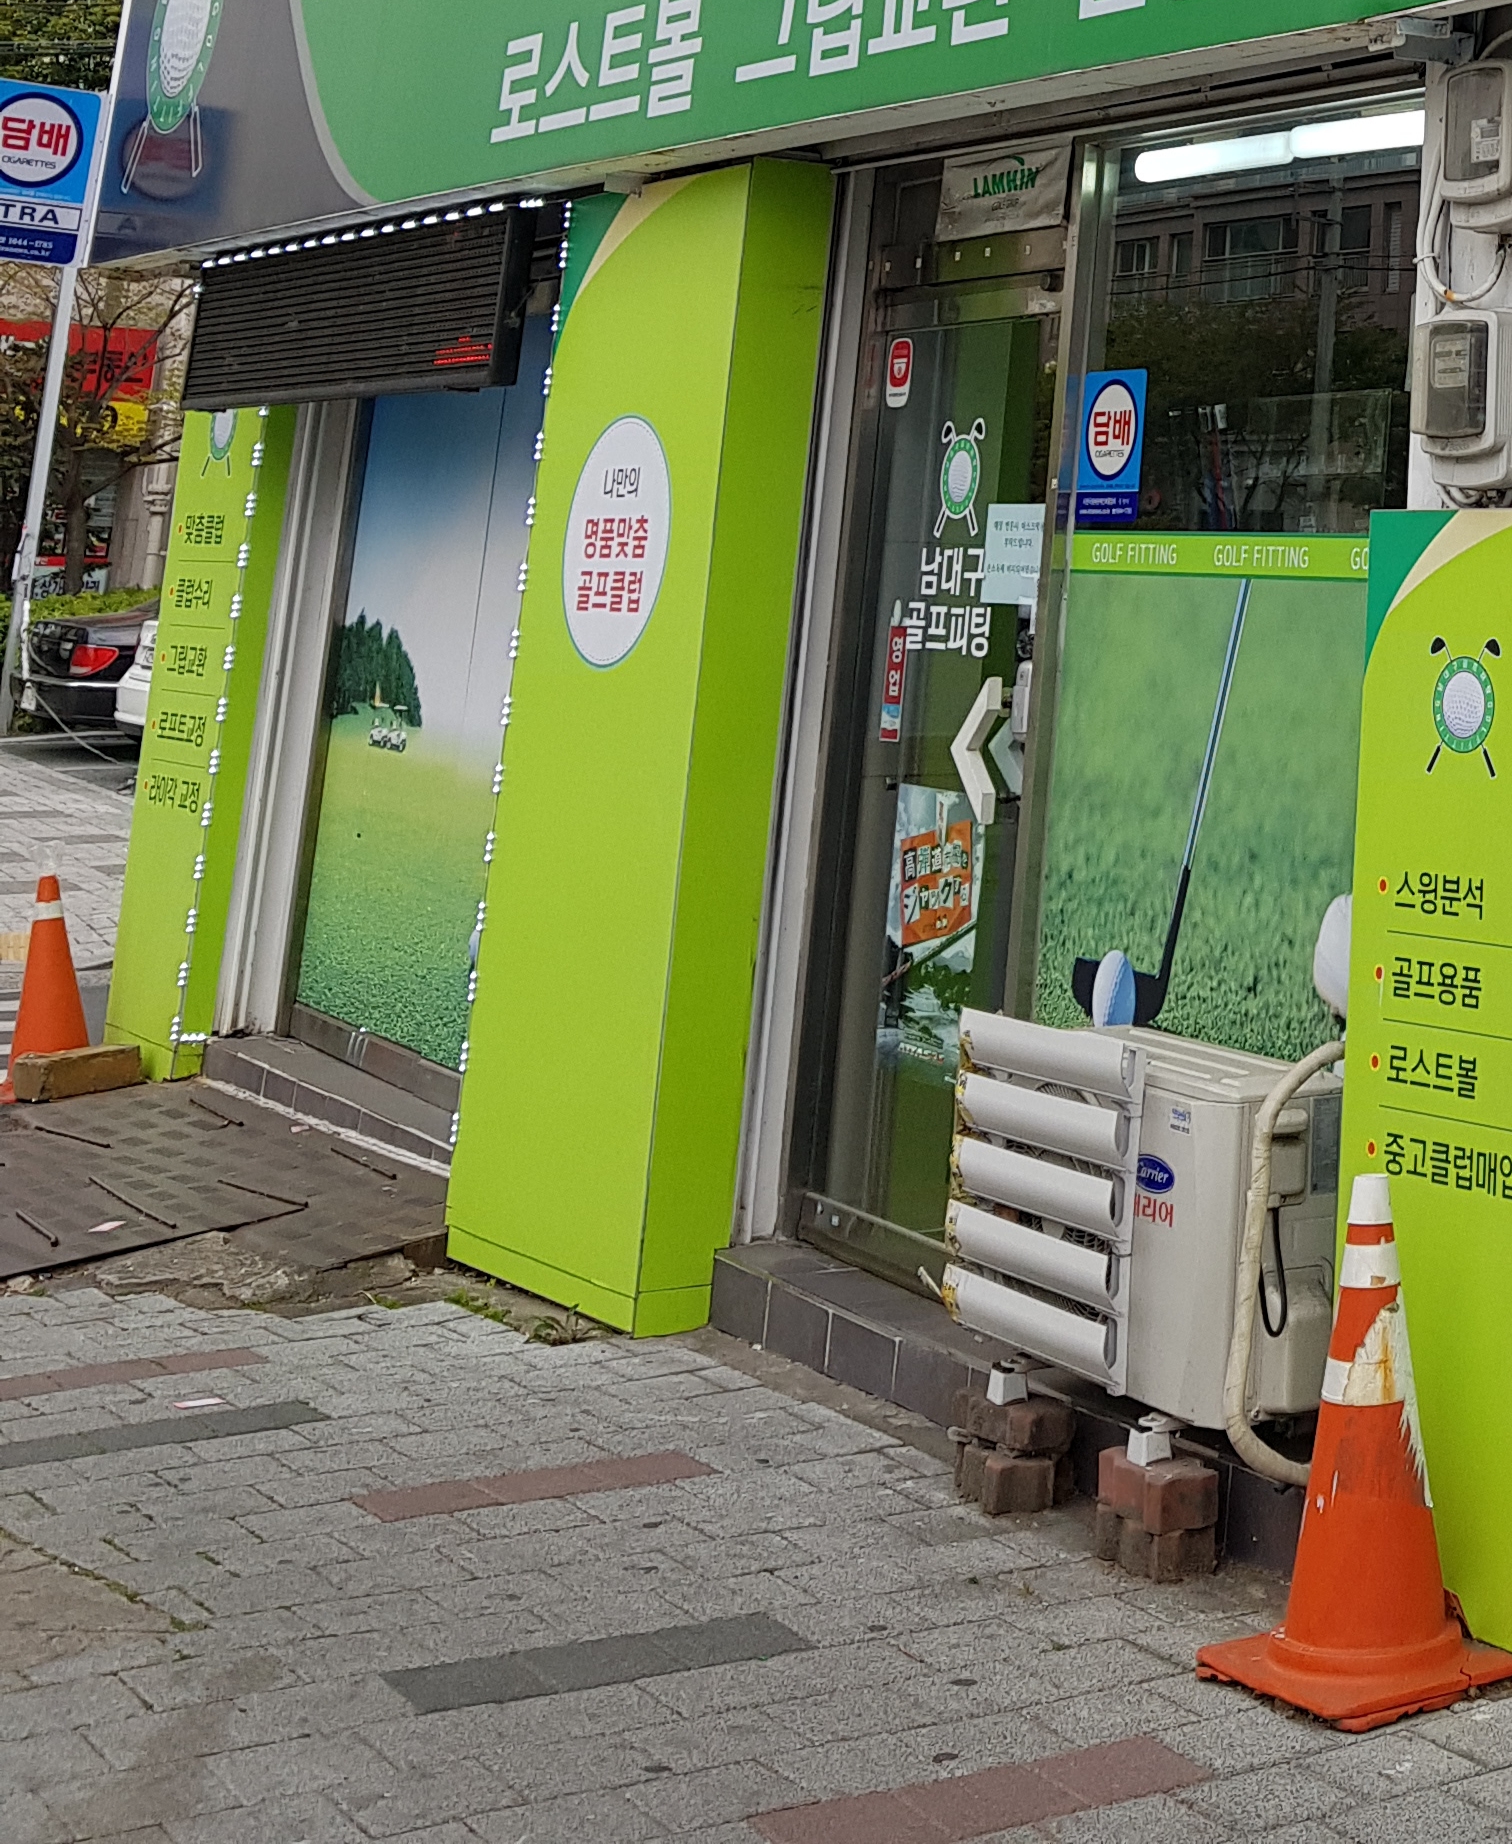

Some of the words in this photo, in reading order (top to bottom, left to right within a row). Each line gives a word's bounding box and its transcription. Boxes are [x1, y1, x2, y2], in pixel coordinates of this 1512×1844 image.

[1, 115, 72, 157] 담배
[1093, 410, 1133, 447] 담배
[603, 466, 642, 498] 나만의
[184, 513, 226, 545] 맞춤클럽
[584, 515, 650, 560] 명품맞춤
[920, 546, 987, 597] 남대구
[1091, 542, 1124, 564] GOLF
[1126, 543, 1178, 566] FITTING
[1213, 544, 1249, 567] GOLF
[1252, 545, 1310, 569] FITTING
[174, 578, 214, 610] 클럽수리
[576, 570, 644, 613] 골프클럽
[903, 601, 992, 658] 골프피팅
[166, 644, 208, 677] 그립교환
[888, 636, 905, 697] 영업
[156, 711, 207, 748] 로프트교정
[148, 774, 178, 809] 라이각
[177, 780, 202, 814] 교정
[1394, 870, 1485, 921] 스윙분석
[1391, 956, 1483, 1010] 골프용품
[1386, 1043, 1480, 1101] 로스트볼
